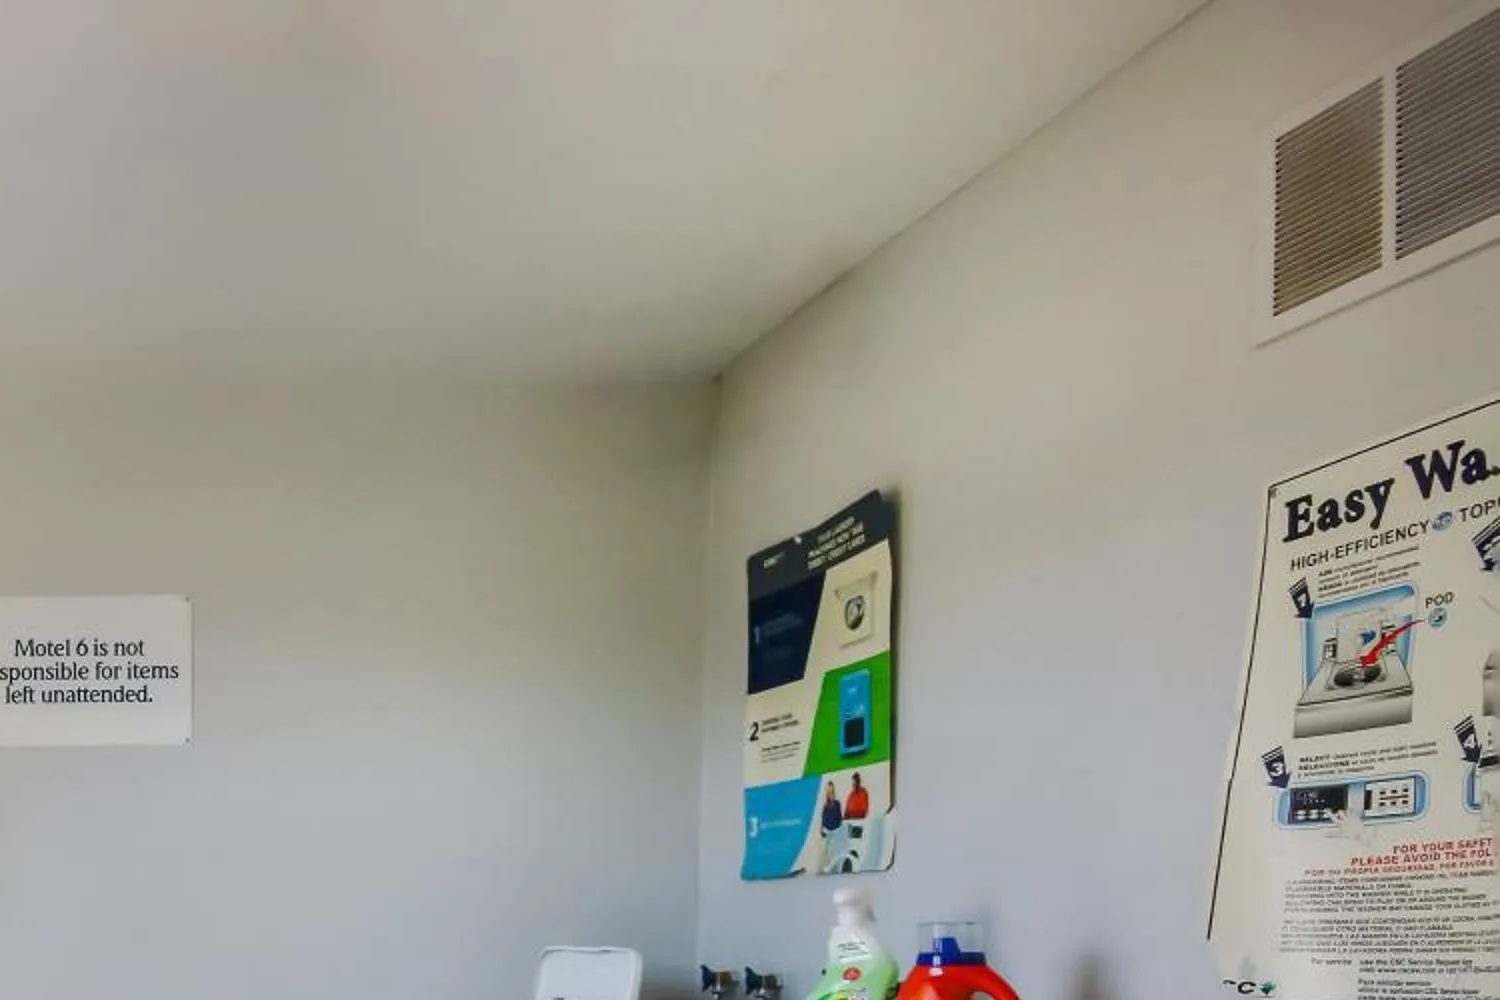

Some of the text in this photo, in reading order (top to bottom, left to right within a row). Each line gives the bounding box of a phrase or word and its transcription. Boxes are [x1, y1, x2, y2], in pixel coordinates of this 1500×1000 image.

[1283, 440, 1500, 543] Easy Wa
[1458, 497, 1500, 523] TOP
[1290, 519, 1430, 571] HIGH-EFFICIENCY
[1425, 591, 1454, 608] POD
[13, 638, 145, 657] Motel 6 is not
[95, 661, 122, 680] for
[127, 661, 180, 680] items
[5, 685, 153, 704] left unattended.
[749, 722, 759, 741] 2
[1270, 760, 1283, 778] 3
[1393, 844, 1417, 854] FOR
[1422, 841, 1454, 853] YOUR
[1351, 855, 1399, 866] PLEASE
[1403, 853, 1441, 864] AVOID
[1445, 850, 1468, 861] THE
